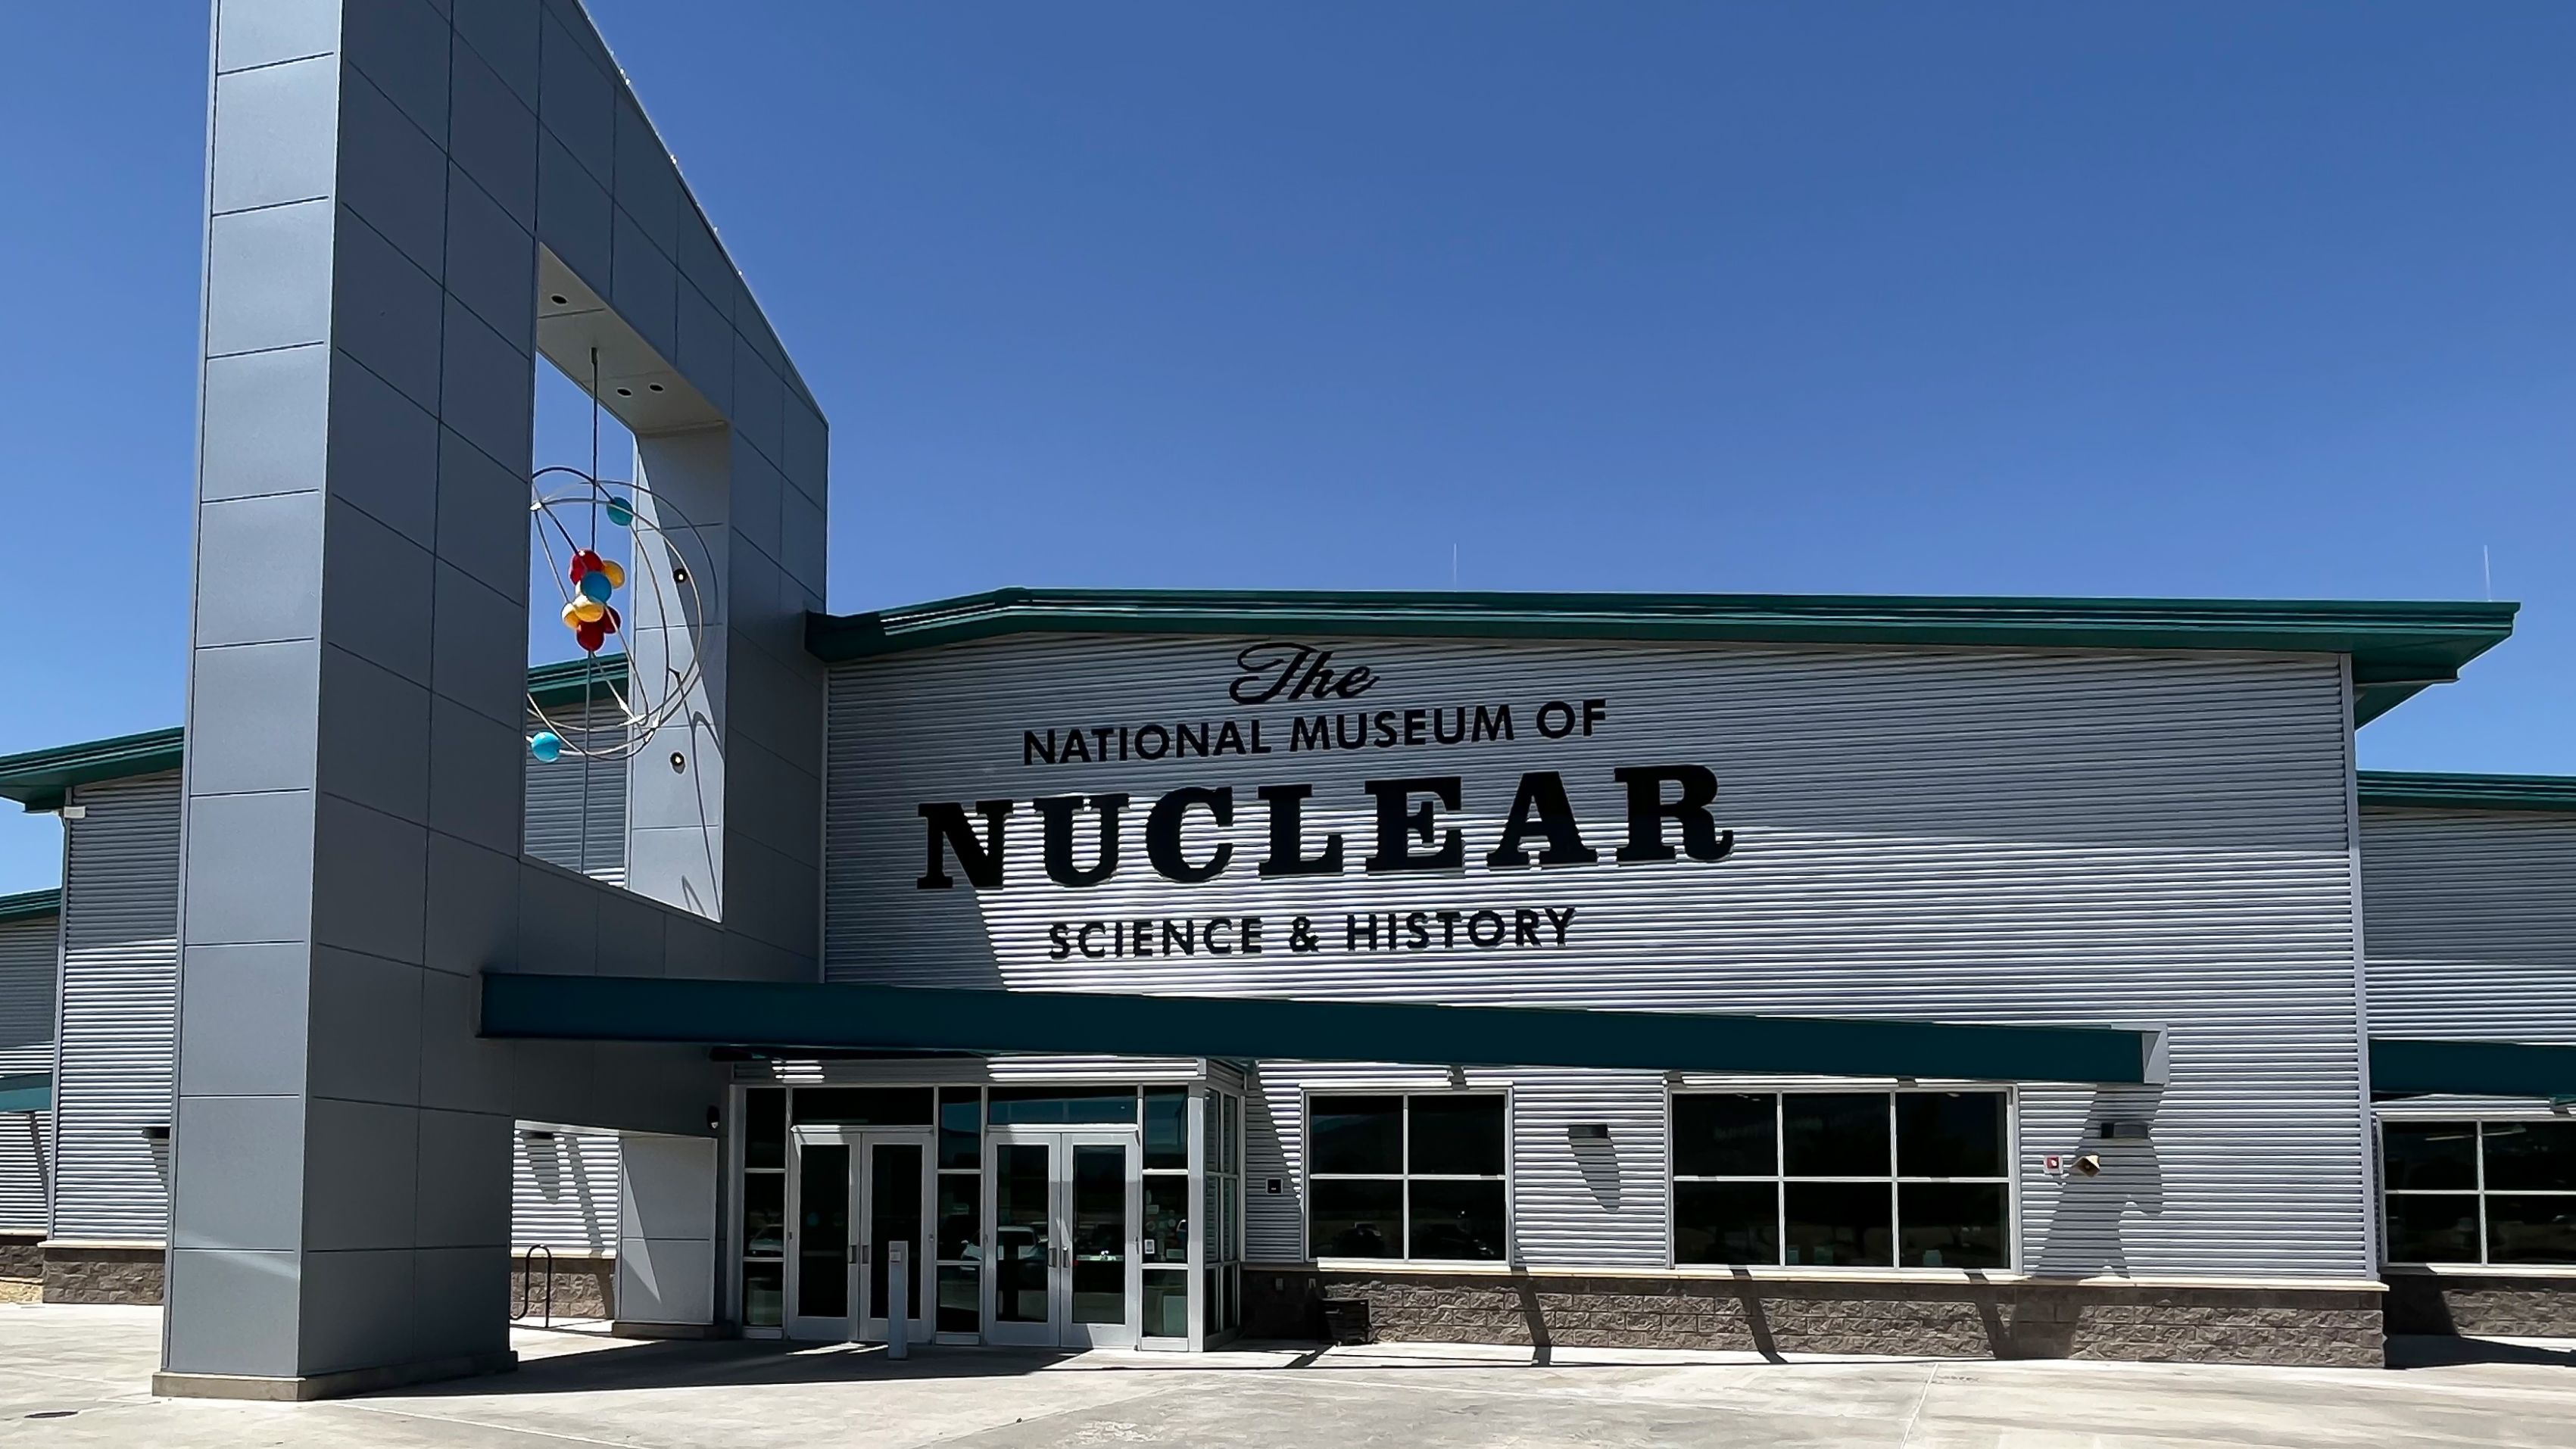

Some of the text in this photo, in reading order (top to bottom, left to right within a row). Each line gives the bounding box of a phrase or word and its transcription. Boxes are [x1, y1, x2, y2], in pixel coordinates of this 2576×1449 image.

[1229, 643, 1380, 705] The
[1023, 699, 1607, 765] NATIONAL MUSEUM OF
[917, 765, 1735, 890] NUCLEAR
[1049, 907, 1576, 959] SCIENCE & HISTORY
